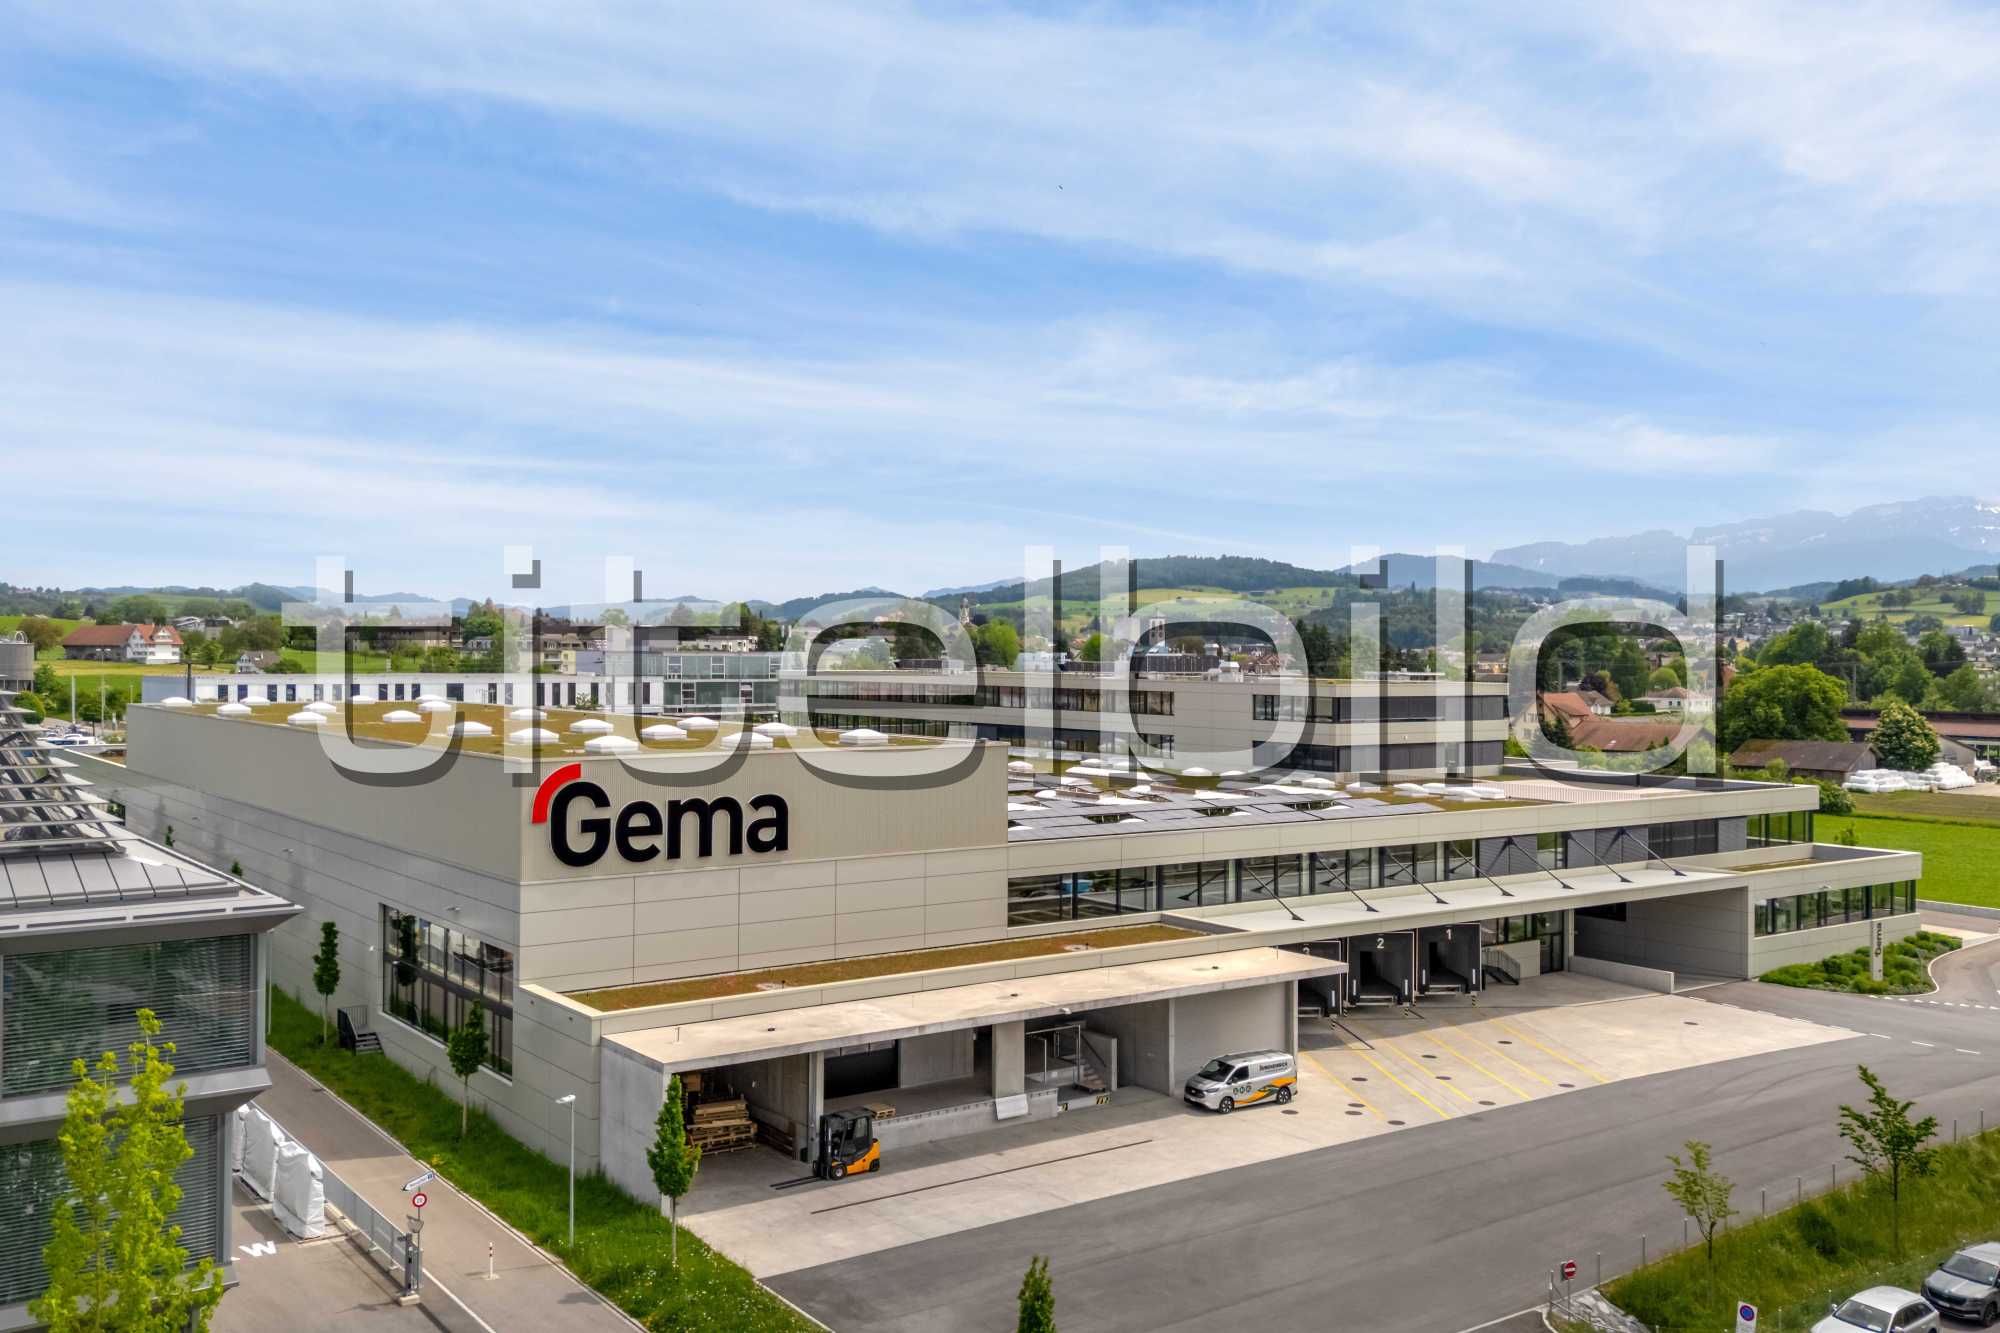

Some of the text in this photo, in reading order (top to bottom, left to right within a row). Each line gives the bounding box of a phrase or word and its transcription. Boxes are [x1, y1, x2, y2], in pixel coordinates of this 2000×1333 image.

[550, 781, 789, 867] Gema
[1446, 929, 1452, 940] 1
[1376, 938, 1385, 949] 2
